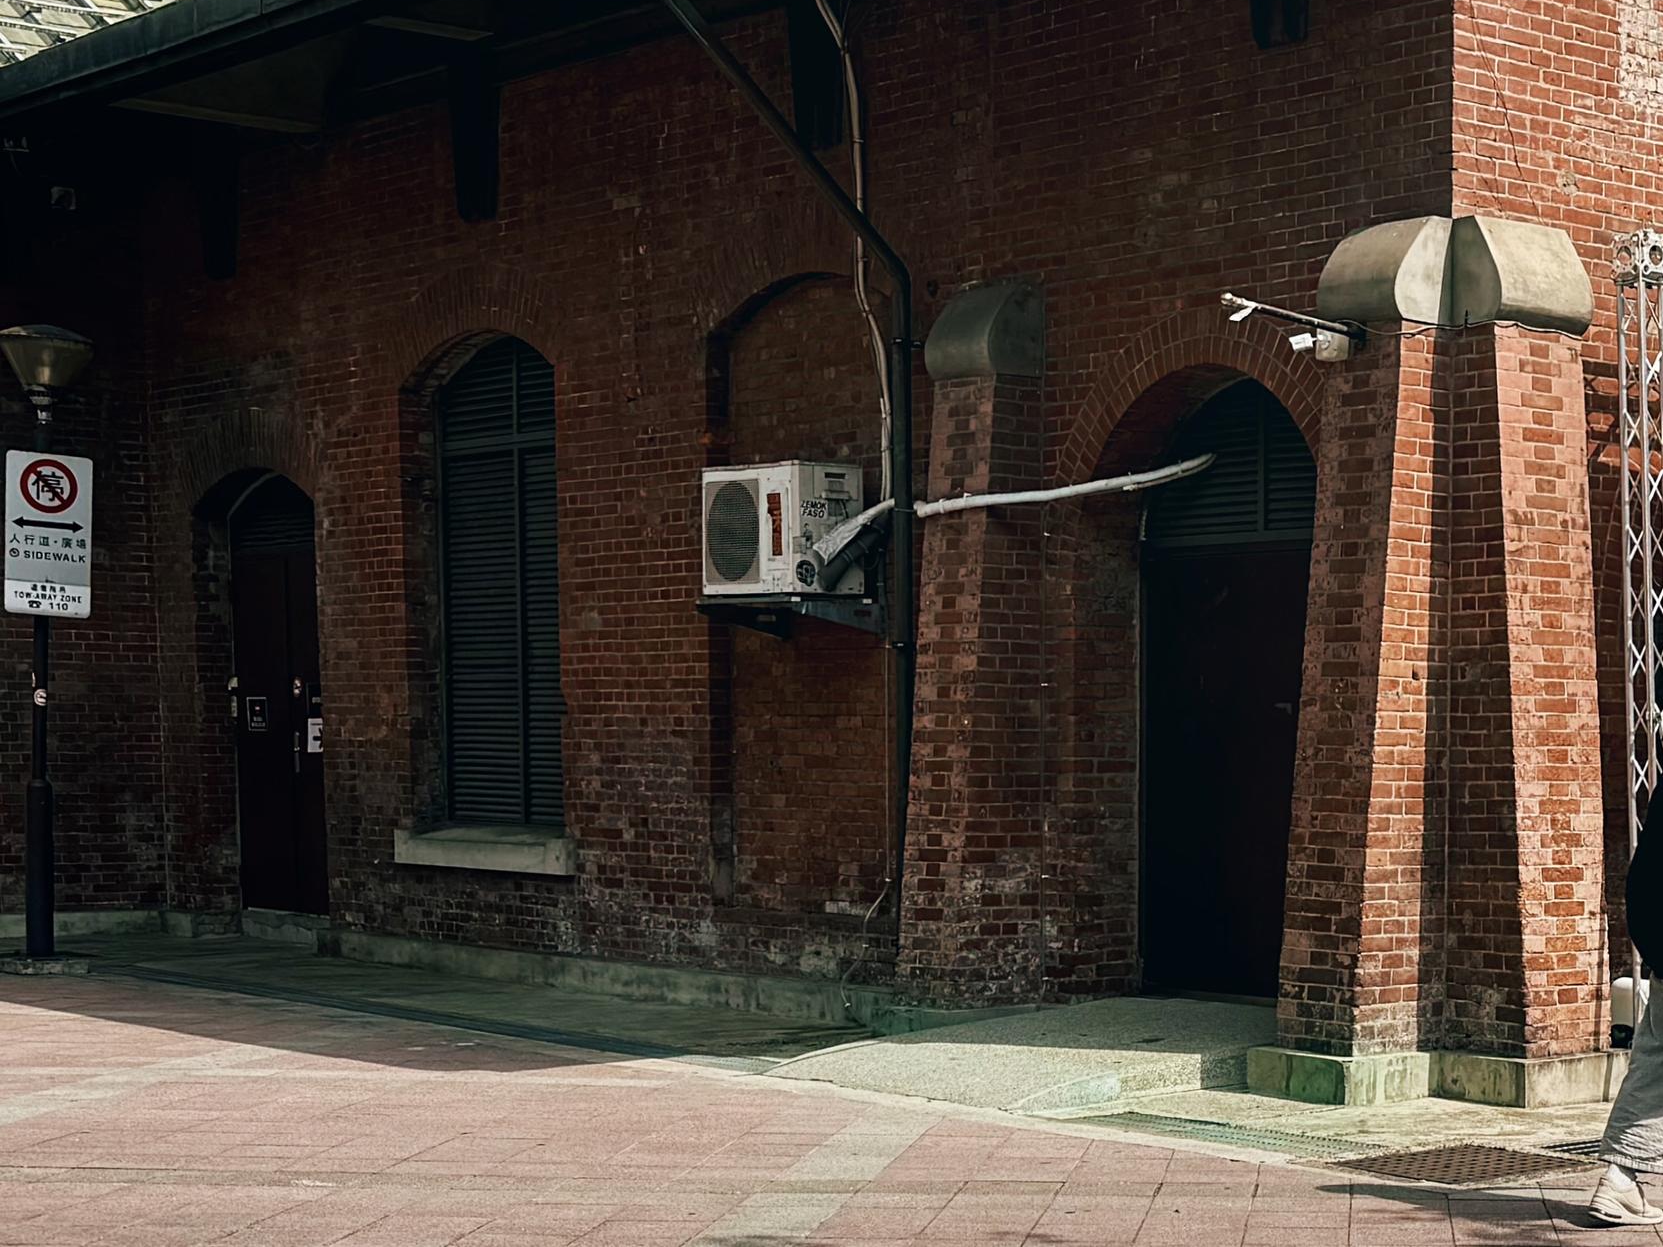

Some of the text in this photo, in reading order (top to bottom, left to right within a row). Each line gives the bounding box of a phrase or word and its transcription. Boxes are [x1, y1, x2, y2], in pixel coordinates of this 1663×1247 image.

[31, 471, 65, 503] 停
[23, 550, 86, 563] SIDEWALK
[60, 595, 82, 603] ZONE
[49, 602, 69, 611] 110
